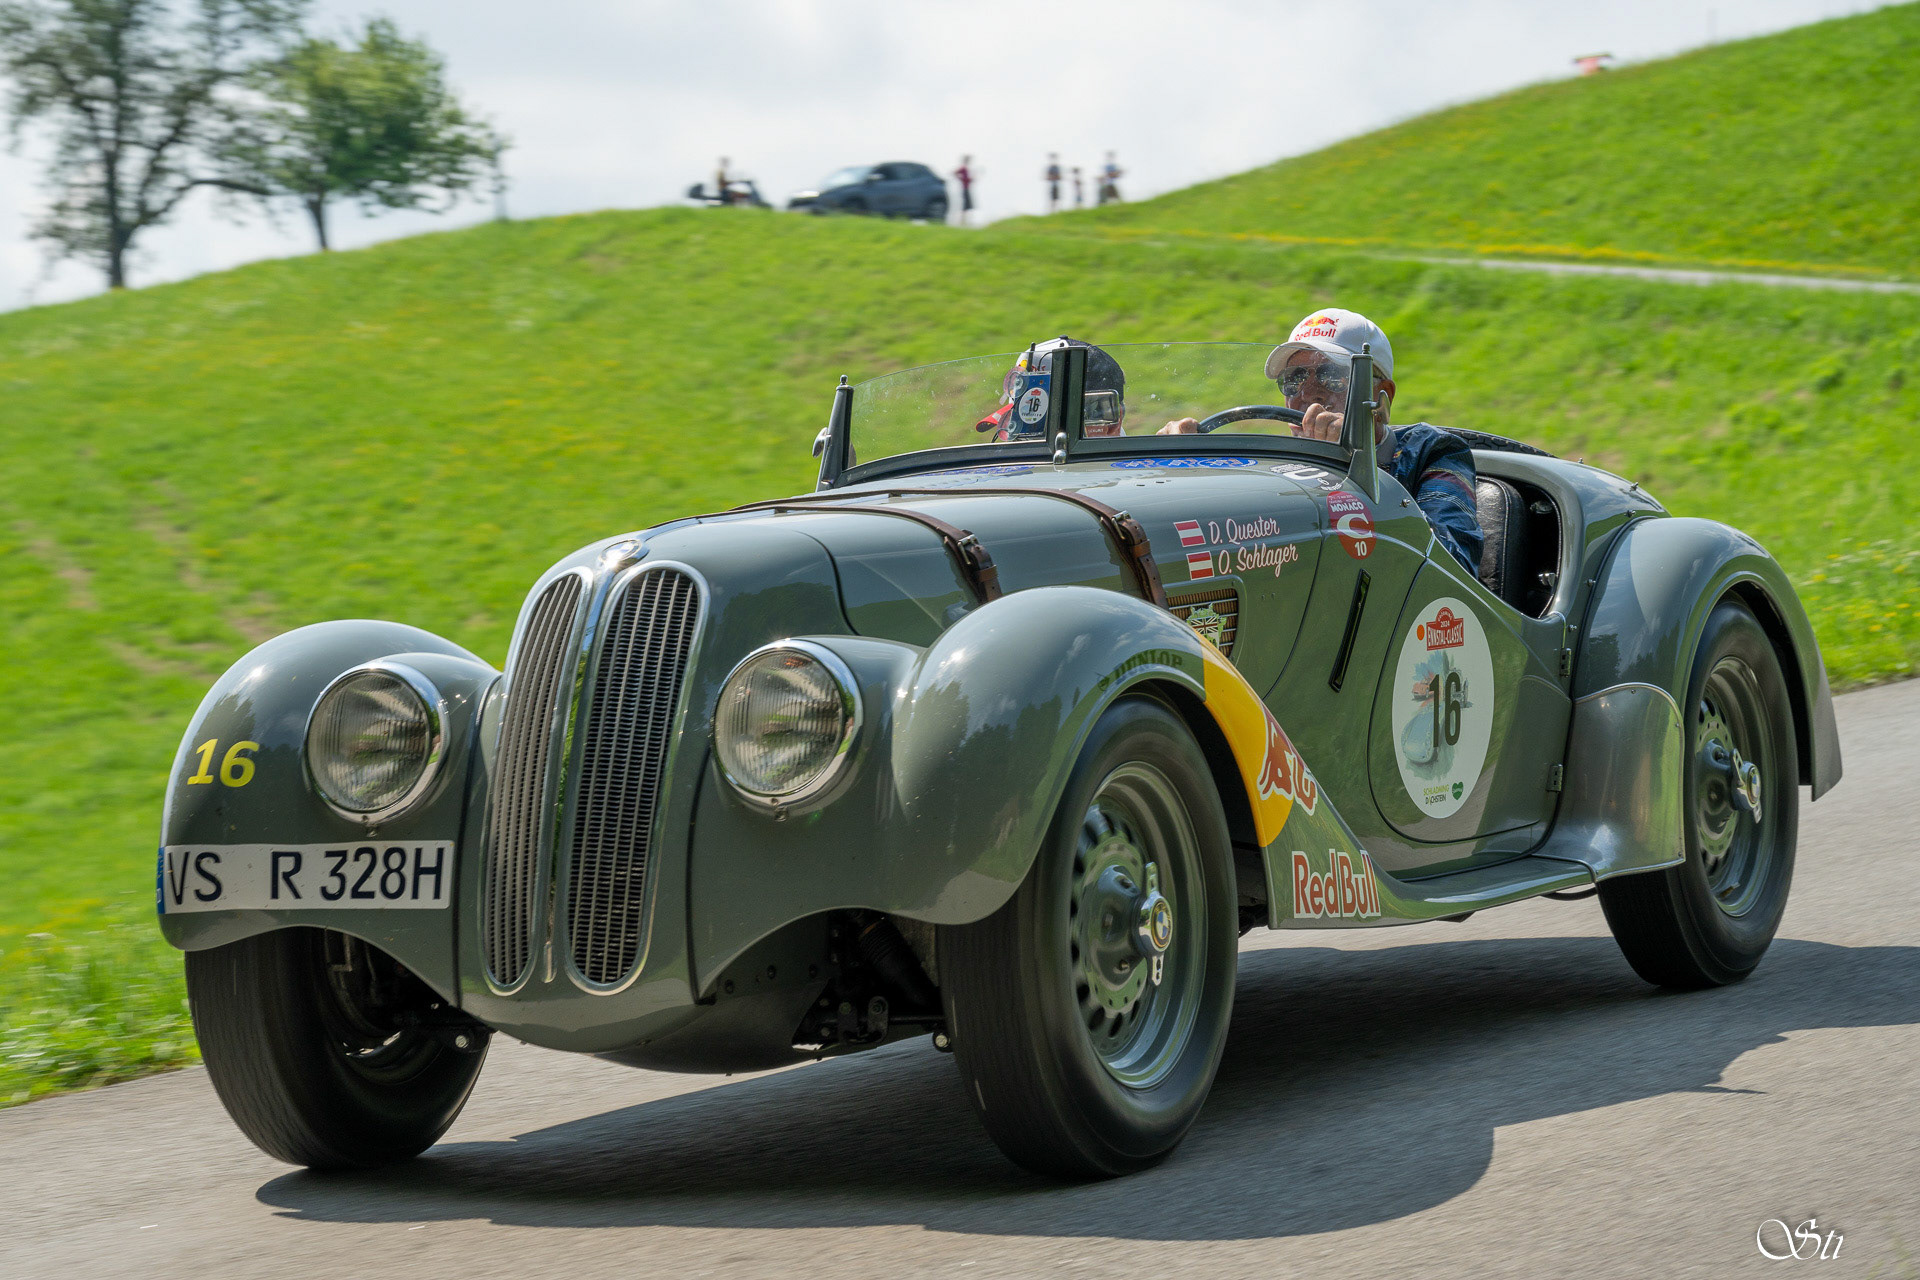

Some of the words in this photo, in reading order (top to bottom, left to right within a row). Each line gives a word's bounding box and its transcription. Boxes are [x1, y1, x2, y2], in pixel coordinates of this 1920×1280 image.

[1312, 328, 1336, 338] Bull
[1028, 397, 1040, 413] 16
[1330, 501, 1364, 512] MONACO
[1208, 521, 1223, 544] D.
[1226, 516, 1280, 545] Quester
[1337, 513, 1373, 539] C
[1218, 550, 1232, 575] O.
[1236, 542, 1298, 578] Schlager
[1354, 541, 1367, 557] 10
[1428, 622, 1463, 647] ENNSTAL-CLASSIC
[1440, 620, 1450, 628] 2024
[1114, 649, 1183, 680] DUNLOP
[1429, 671, 1461, 748] 16
[187, 738, 260, 788] 16
[1423, 784, 1450, 796] SCHLADMING
[168, 851, 222, 905] VS
[271, 851, 302, 900] R
[320, 847, 444, 900] 328H
[1292, 849, 1340, 918] Red
[1337, 850, 1381, 918] Bull
